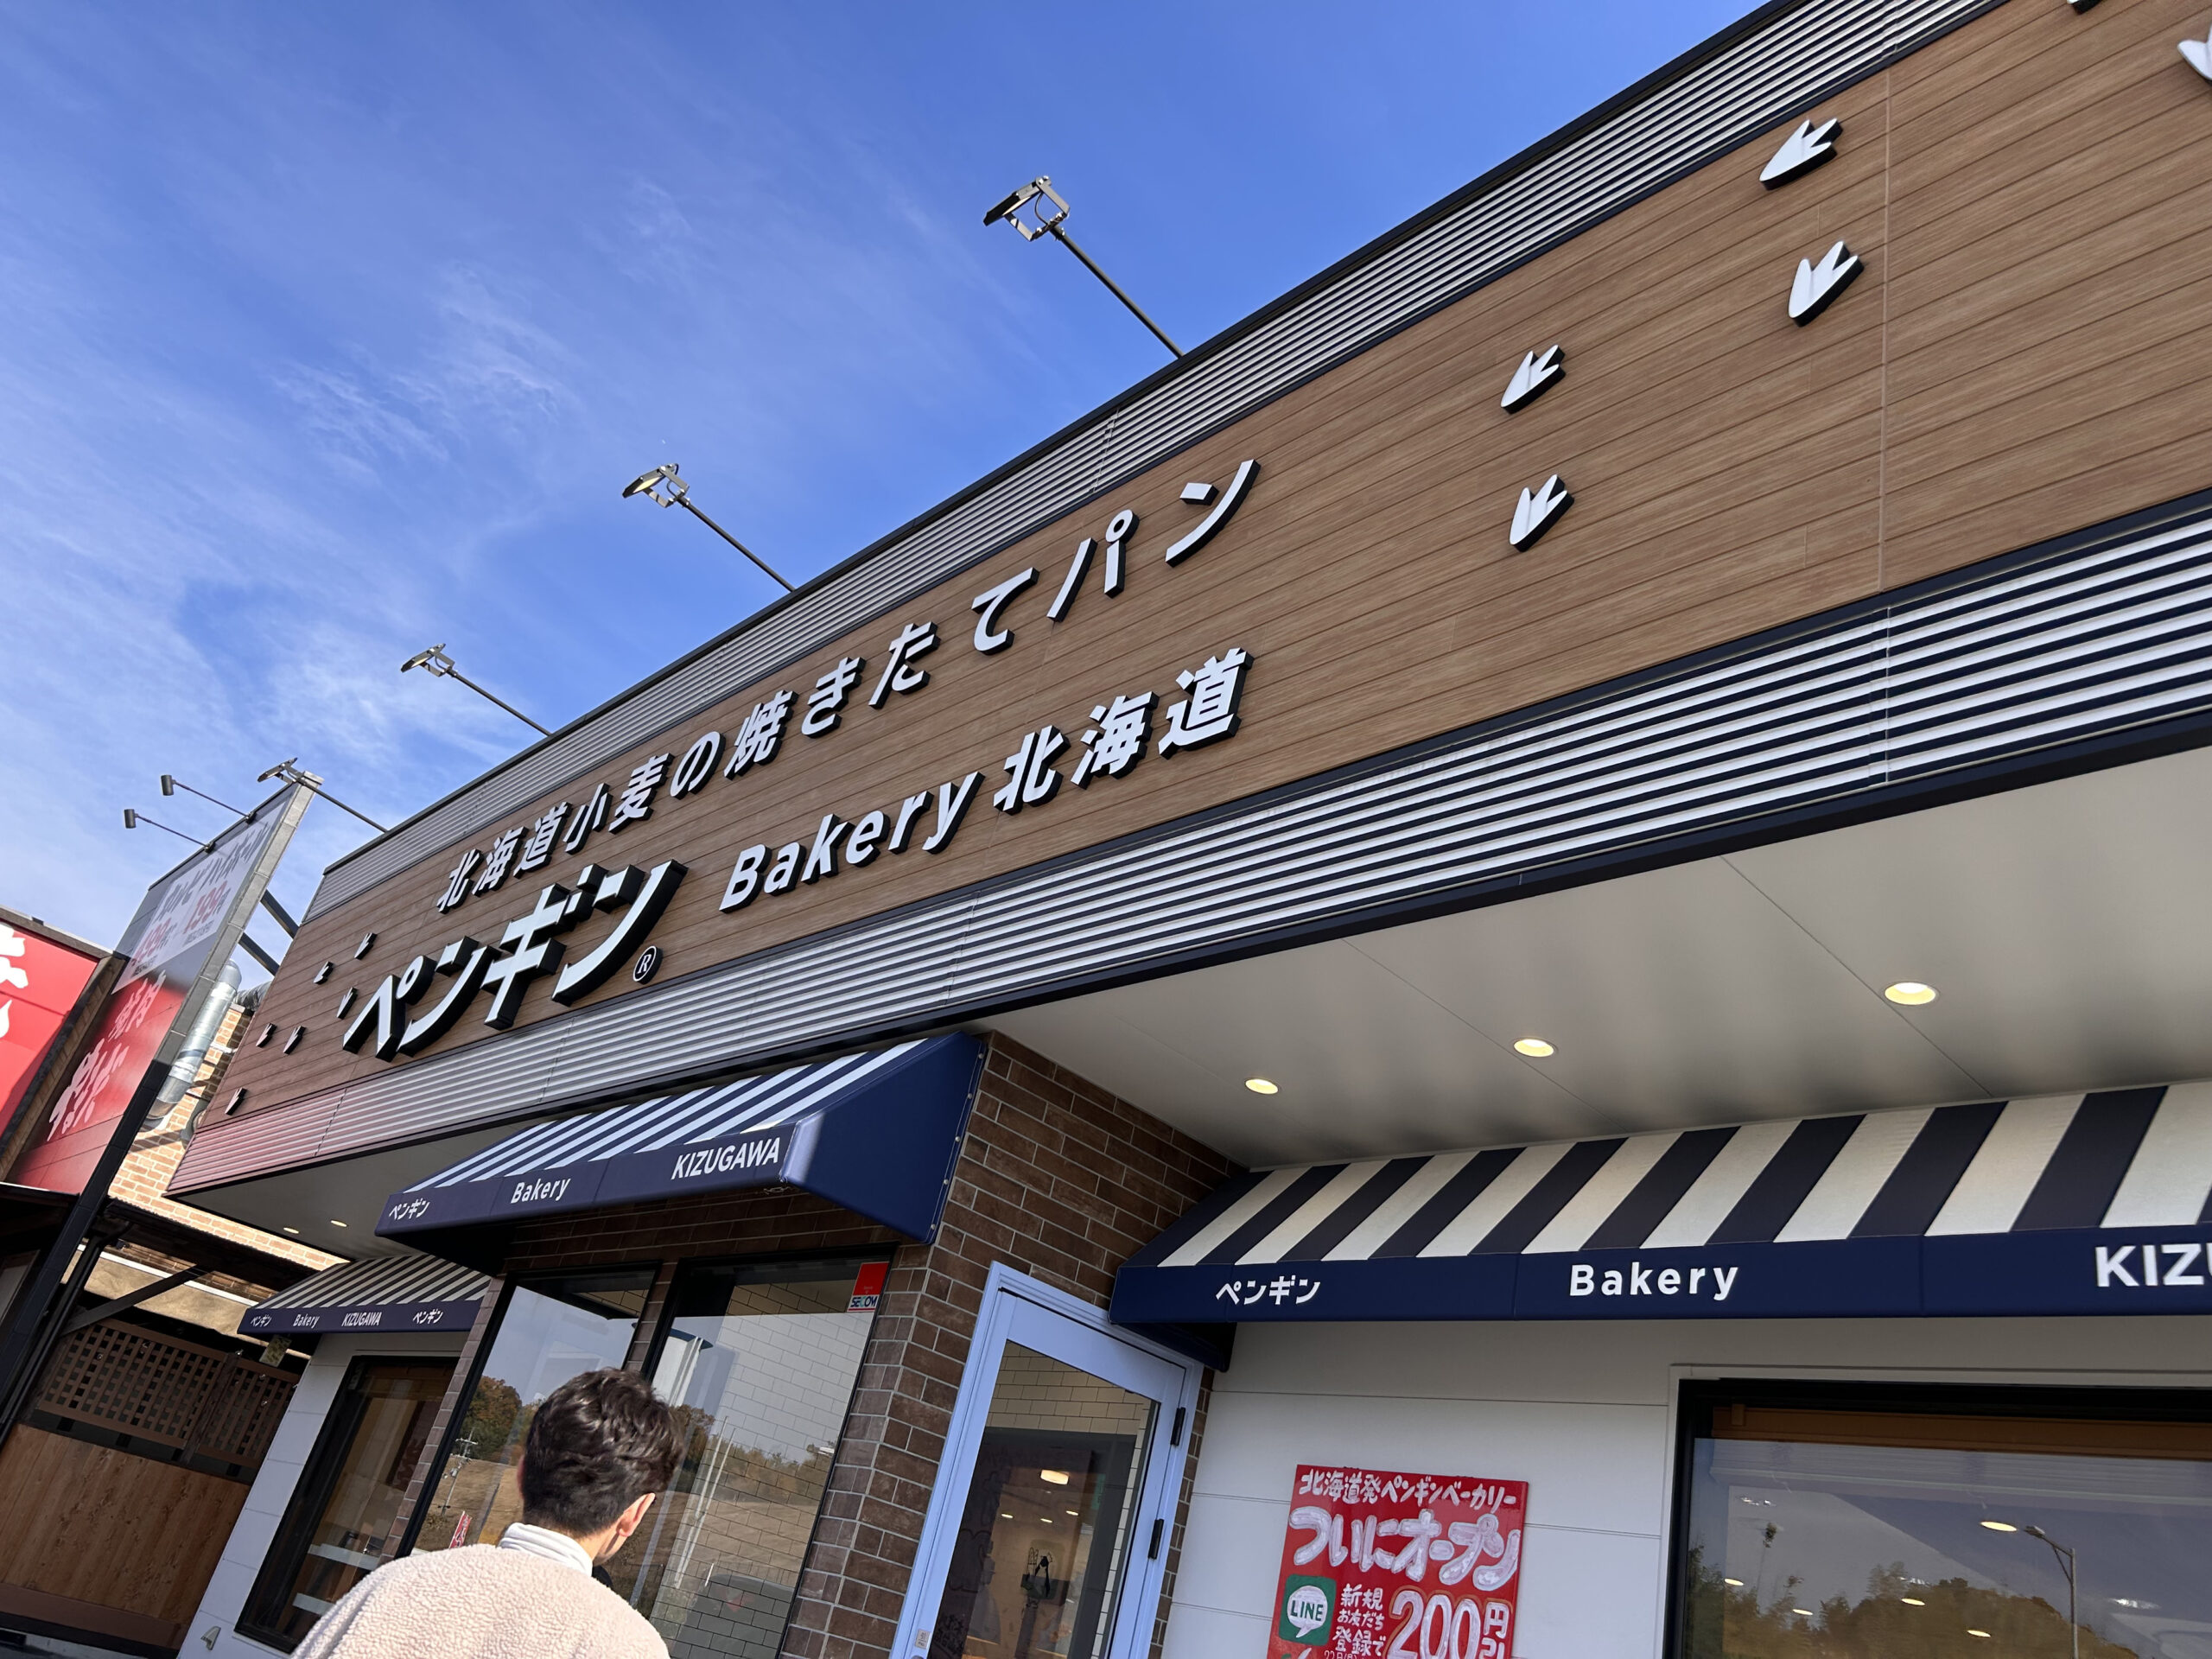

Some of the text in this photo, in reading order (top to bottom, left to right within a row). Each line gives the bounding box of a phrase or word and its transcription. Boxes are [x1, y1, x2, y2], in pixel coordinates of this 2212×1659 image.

[435, 459, 1260, 913] 北海道小麦の焼きたてパン
[345, 859, 688, 1060] ペンギン
[720, 771, 983, 912] Bakery
[993, 648, 1254, 813] 北海道
[389, 1137, 782, 1221] ペンギン Bakery KIZUGAWA
[1215, 1243, 2212, 1306] ペンギン Bakery KIZ
[250, 1307, 444, 1329] ペンギン Bakery KIZUGAWA ペンギン
[850, 1295, 879, 1308] SECOM
[1298, 1468, 1517, 1512] 北海道発ペンギンベーカリー
[1288, 1505, 1522, 1592] ついにオープン
[1290, 1600, 1324, 1621] LINE
[1340, 1583, 1383, 1611] 新規
[1336, 1608, 1386, 1631] お友だち
[1332, 1624, 1388, 1657] 登録で
